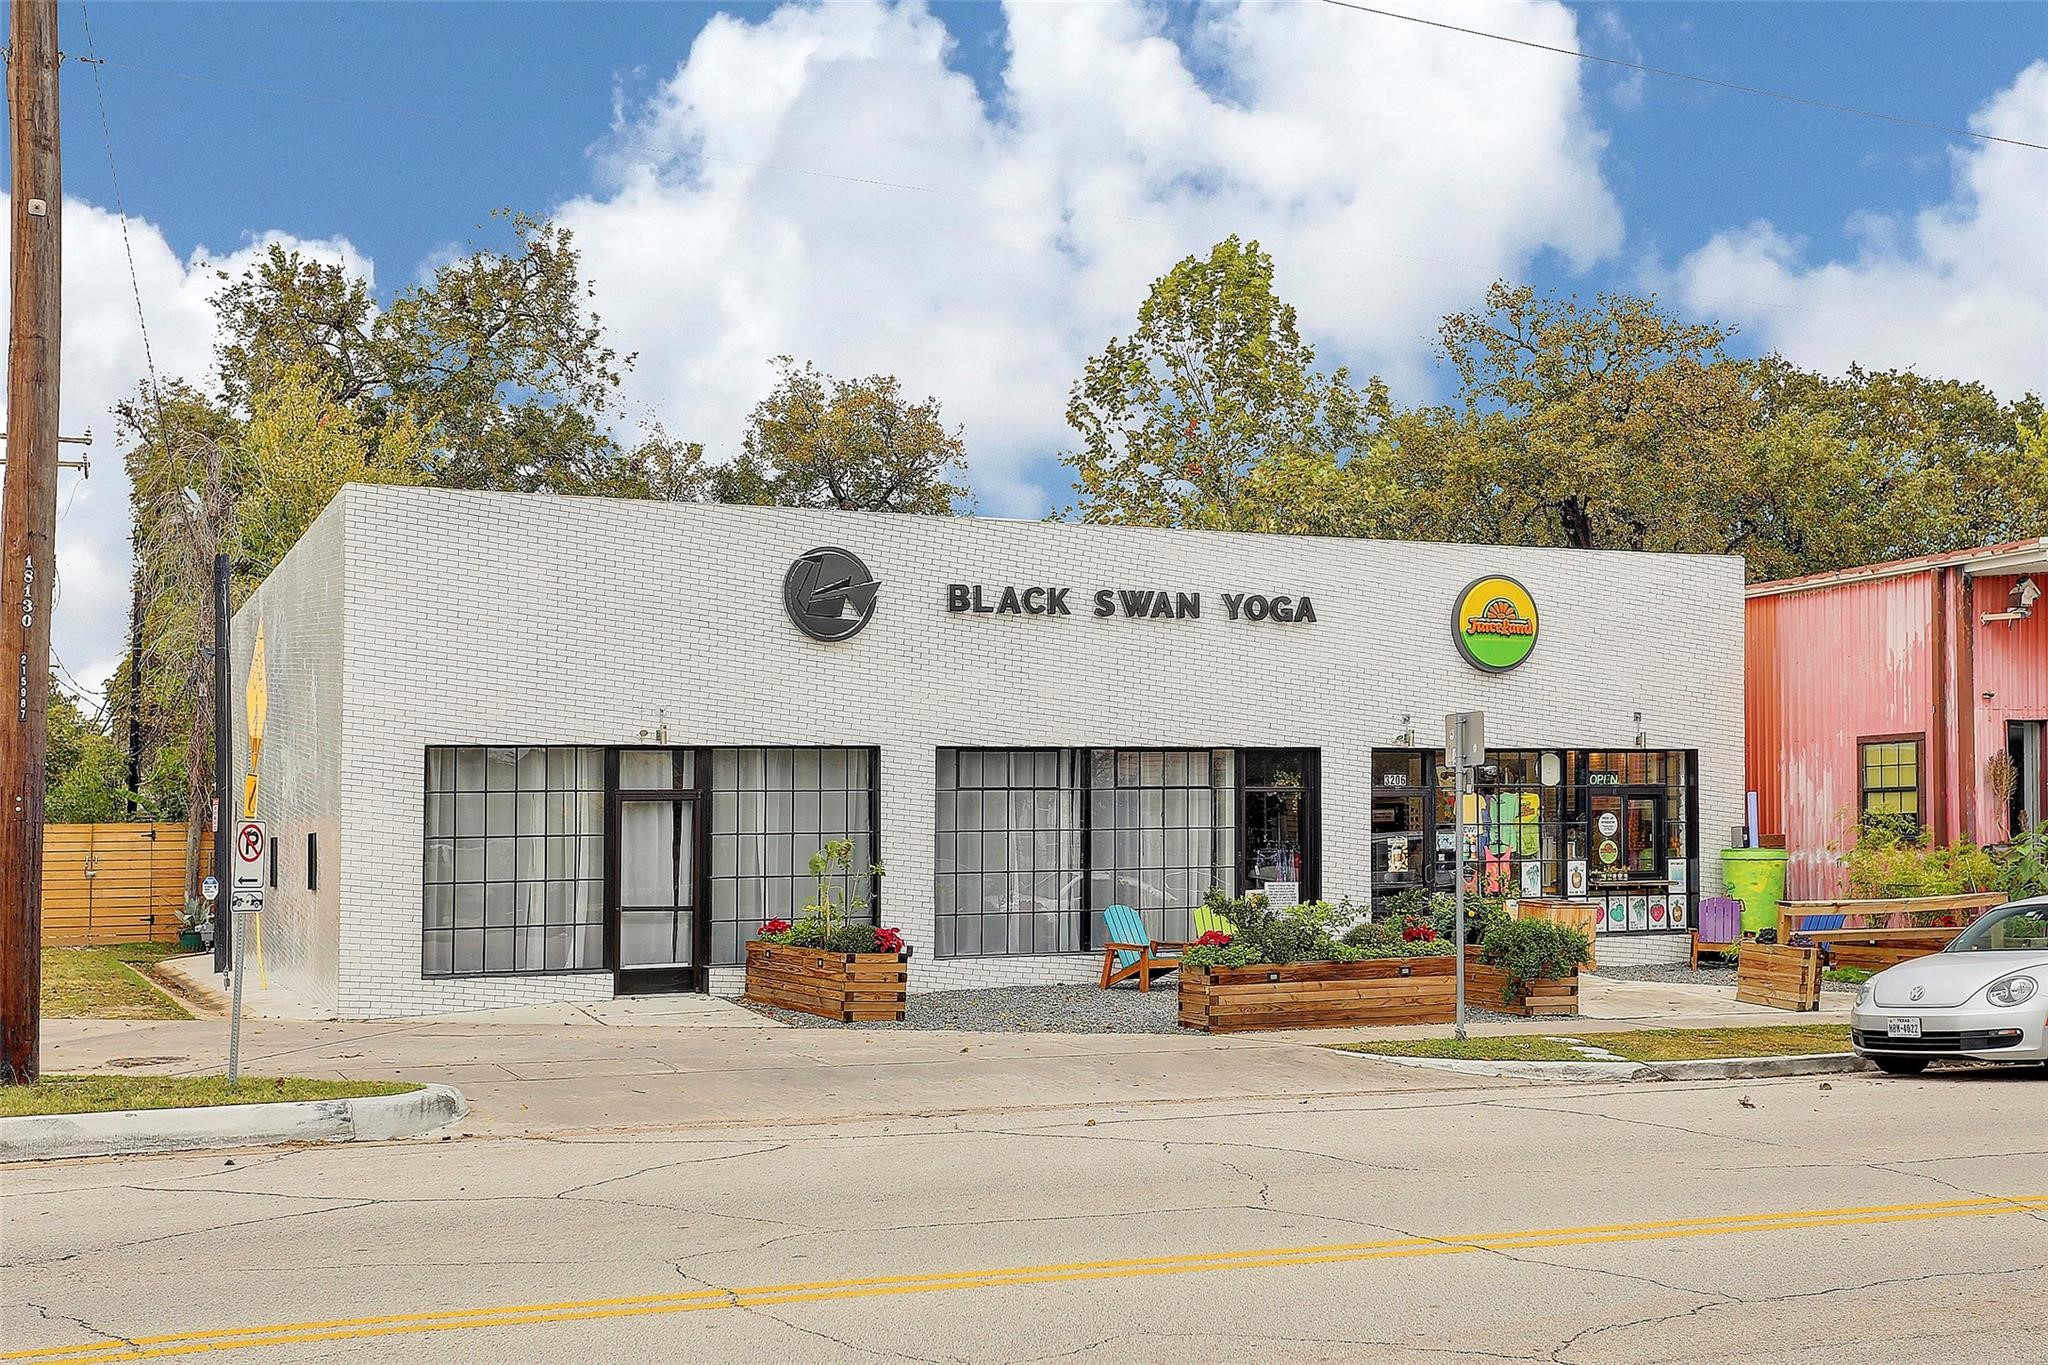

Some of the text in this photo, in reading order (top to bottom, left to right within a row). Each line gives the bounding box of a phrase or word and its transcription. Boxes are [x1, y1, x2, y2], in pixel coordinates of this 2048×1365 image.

[947, 584, 1317, 623] BLACK SWAN YOGA
[1467, 617, 1533, 637] JuiceLand
[19, 654, 28, 720] 215987
[1384, 775, 1407, 785] 3206
[1589, 774, 1618, 785] OPEN
